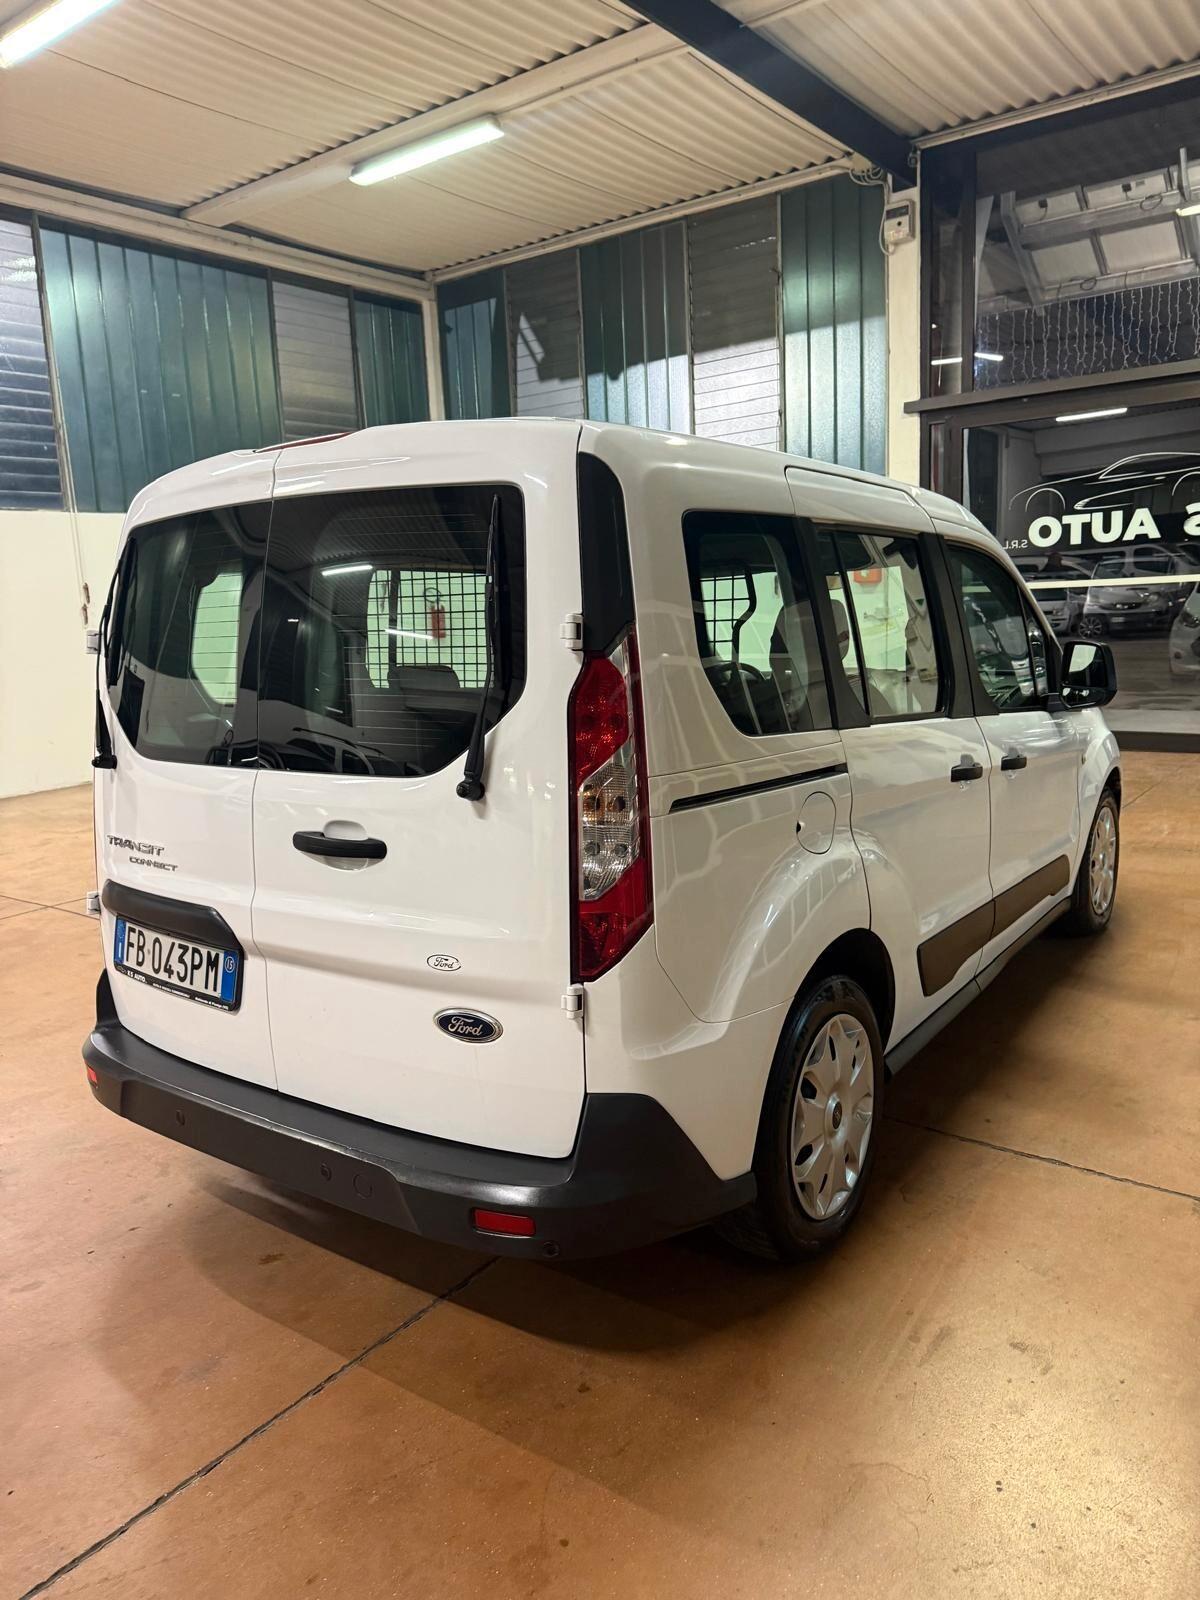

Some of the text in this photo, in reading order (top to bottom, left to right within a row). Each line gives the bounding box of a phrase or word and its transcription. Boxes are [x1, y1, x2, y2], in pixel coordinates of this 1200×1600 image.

[107, 834, 165, 856] TRANSIT
[129, 856, 178, 872] CONNECT
[433, 956, 455, 969] Ford
[448, 1016, 483, 1035] Ford
